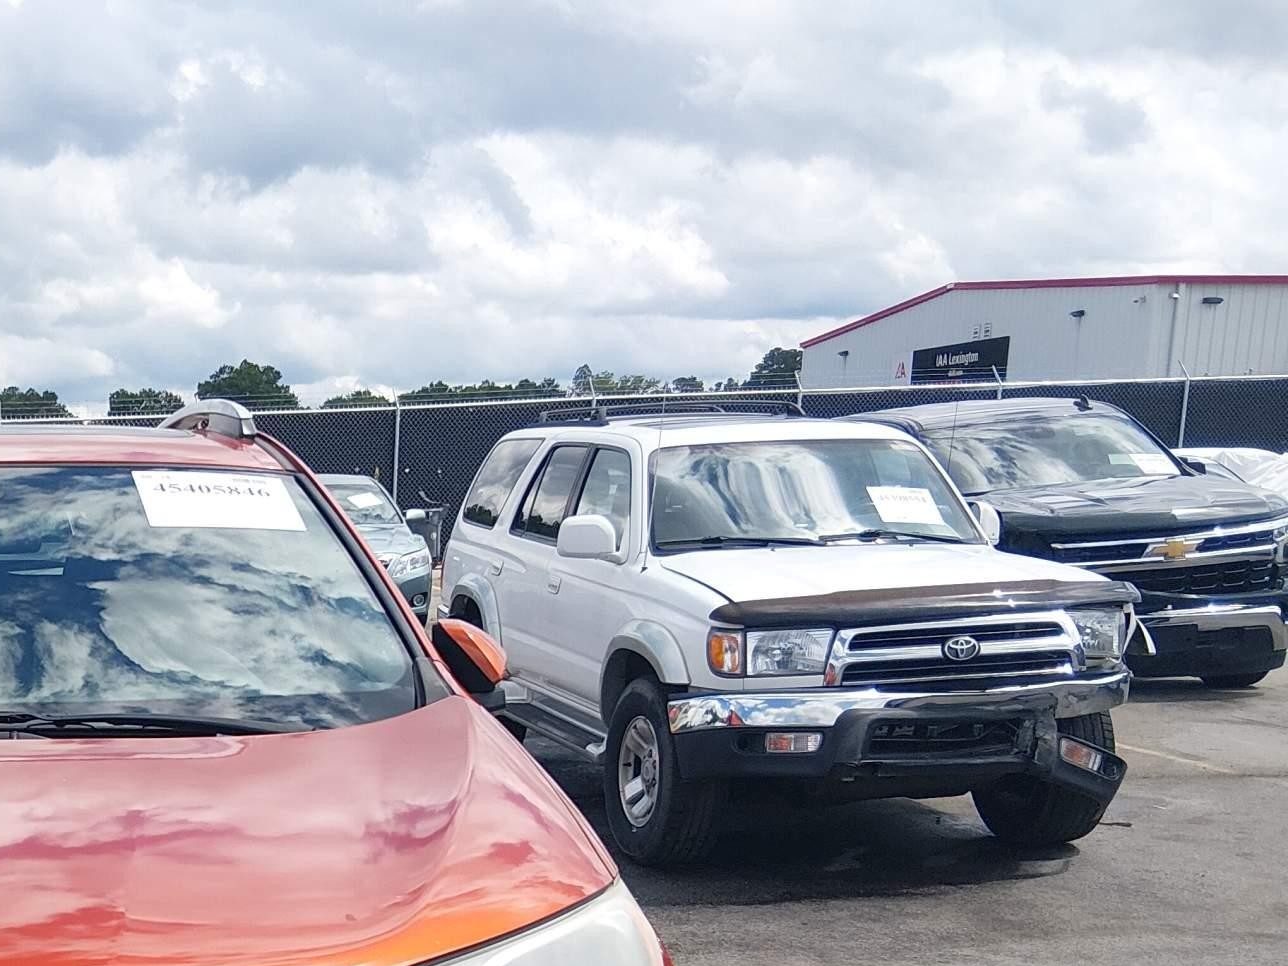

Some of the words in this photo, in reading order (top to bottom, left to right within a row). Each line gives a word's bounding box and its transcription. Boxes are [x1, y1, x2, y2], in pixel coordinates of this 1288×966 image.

[935, 354, 948, 367] IAA
[948, 351, 979, 366] Lexington
[152, 483, 271, 497] 45405846
